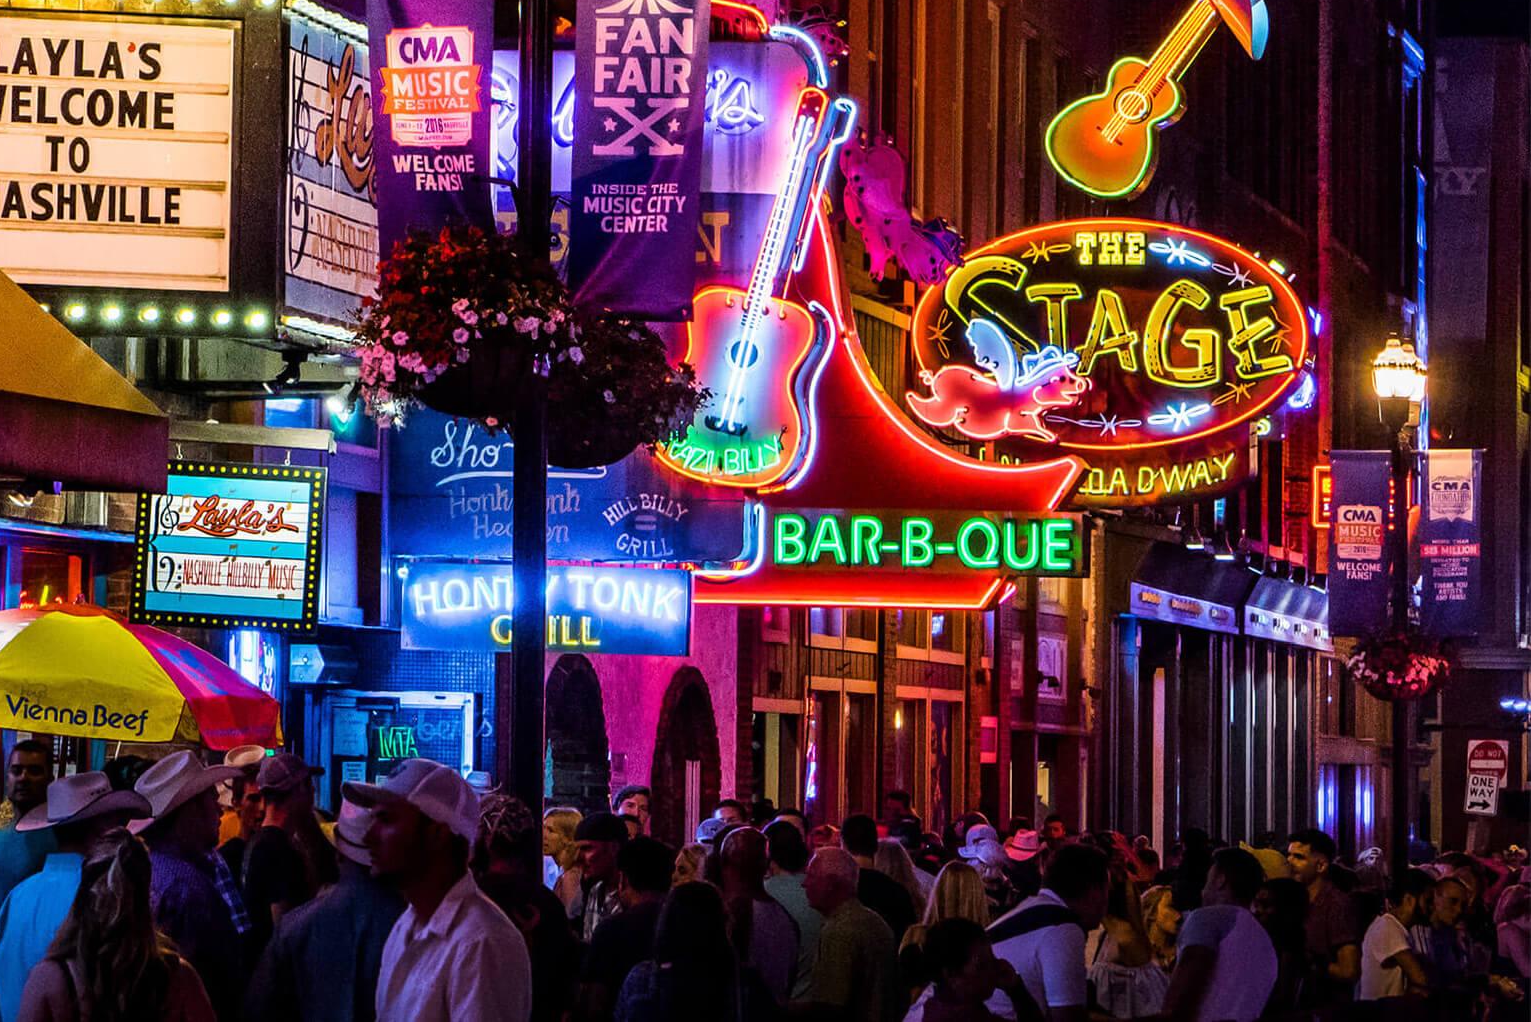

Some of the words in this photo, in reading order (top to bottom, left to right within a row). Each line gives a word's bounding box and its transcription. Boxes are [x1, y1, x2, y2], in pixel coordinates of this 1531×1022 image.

[595, 17, 694, 54] FAN
[399, 37, 461, 64] CMA
[391, 71, 470, 97] MUSIC
[594, 57, 692, 94] FAIR
[393, 97, 469, 111] FESTIVAL
[425, 118, 444, 133] 2016
[45, 135, 90, 173] TO
[392, 154, 475, 174] WELCOME
[415, 173, 464, 192] FANS!
[591, 184, 647, 195] INSIDE
[651, 183, 678, 194] THE
[583, 196, 642, 214] MUSIC
[647, 195, 687, 214] CITY
[600, 215, 668, 234] CENTER
[1076, 232, 1145, 265] THE
[945, 255, 1295, 389] STAGE
[1431, 481, 1471, 491] CMA
[177, 494, 299, 537] Layla's
[602, 496, 637, 527] HILL
[638, 492, 689, 522] BILLY
[1343, 509, 1377, 523] CMA
[1339, 525, 1381, 538] MUSIC
[616, 533, 674, 557] GRILL
[774, 514, 1074, 572] BAR-B-QUE
[1442, 544, 1477, 555] MILLION
[183, 559, 222, 586] NASHVILLE
[226, 560, 265, 589] HILLBILLY
[268, 562, 298, 591] MUSIC
[1337, 562, 1382, 572] WELCOME
[1347, 571, 1372, 581] FANS!
[567, 574, 685, 622] TONK
[490, 615, 601, 646] GILL
[6, 694, 87, 726] Vienna
[92, 704, 149, 737] Beef
[1474, 749, 1485, 758] DO
[1488, 749, 1502, 758] NOT
[1471, 776, 1494, 787] ONE
[1470, 787, 1494, 798] WAY
